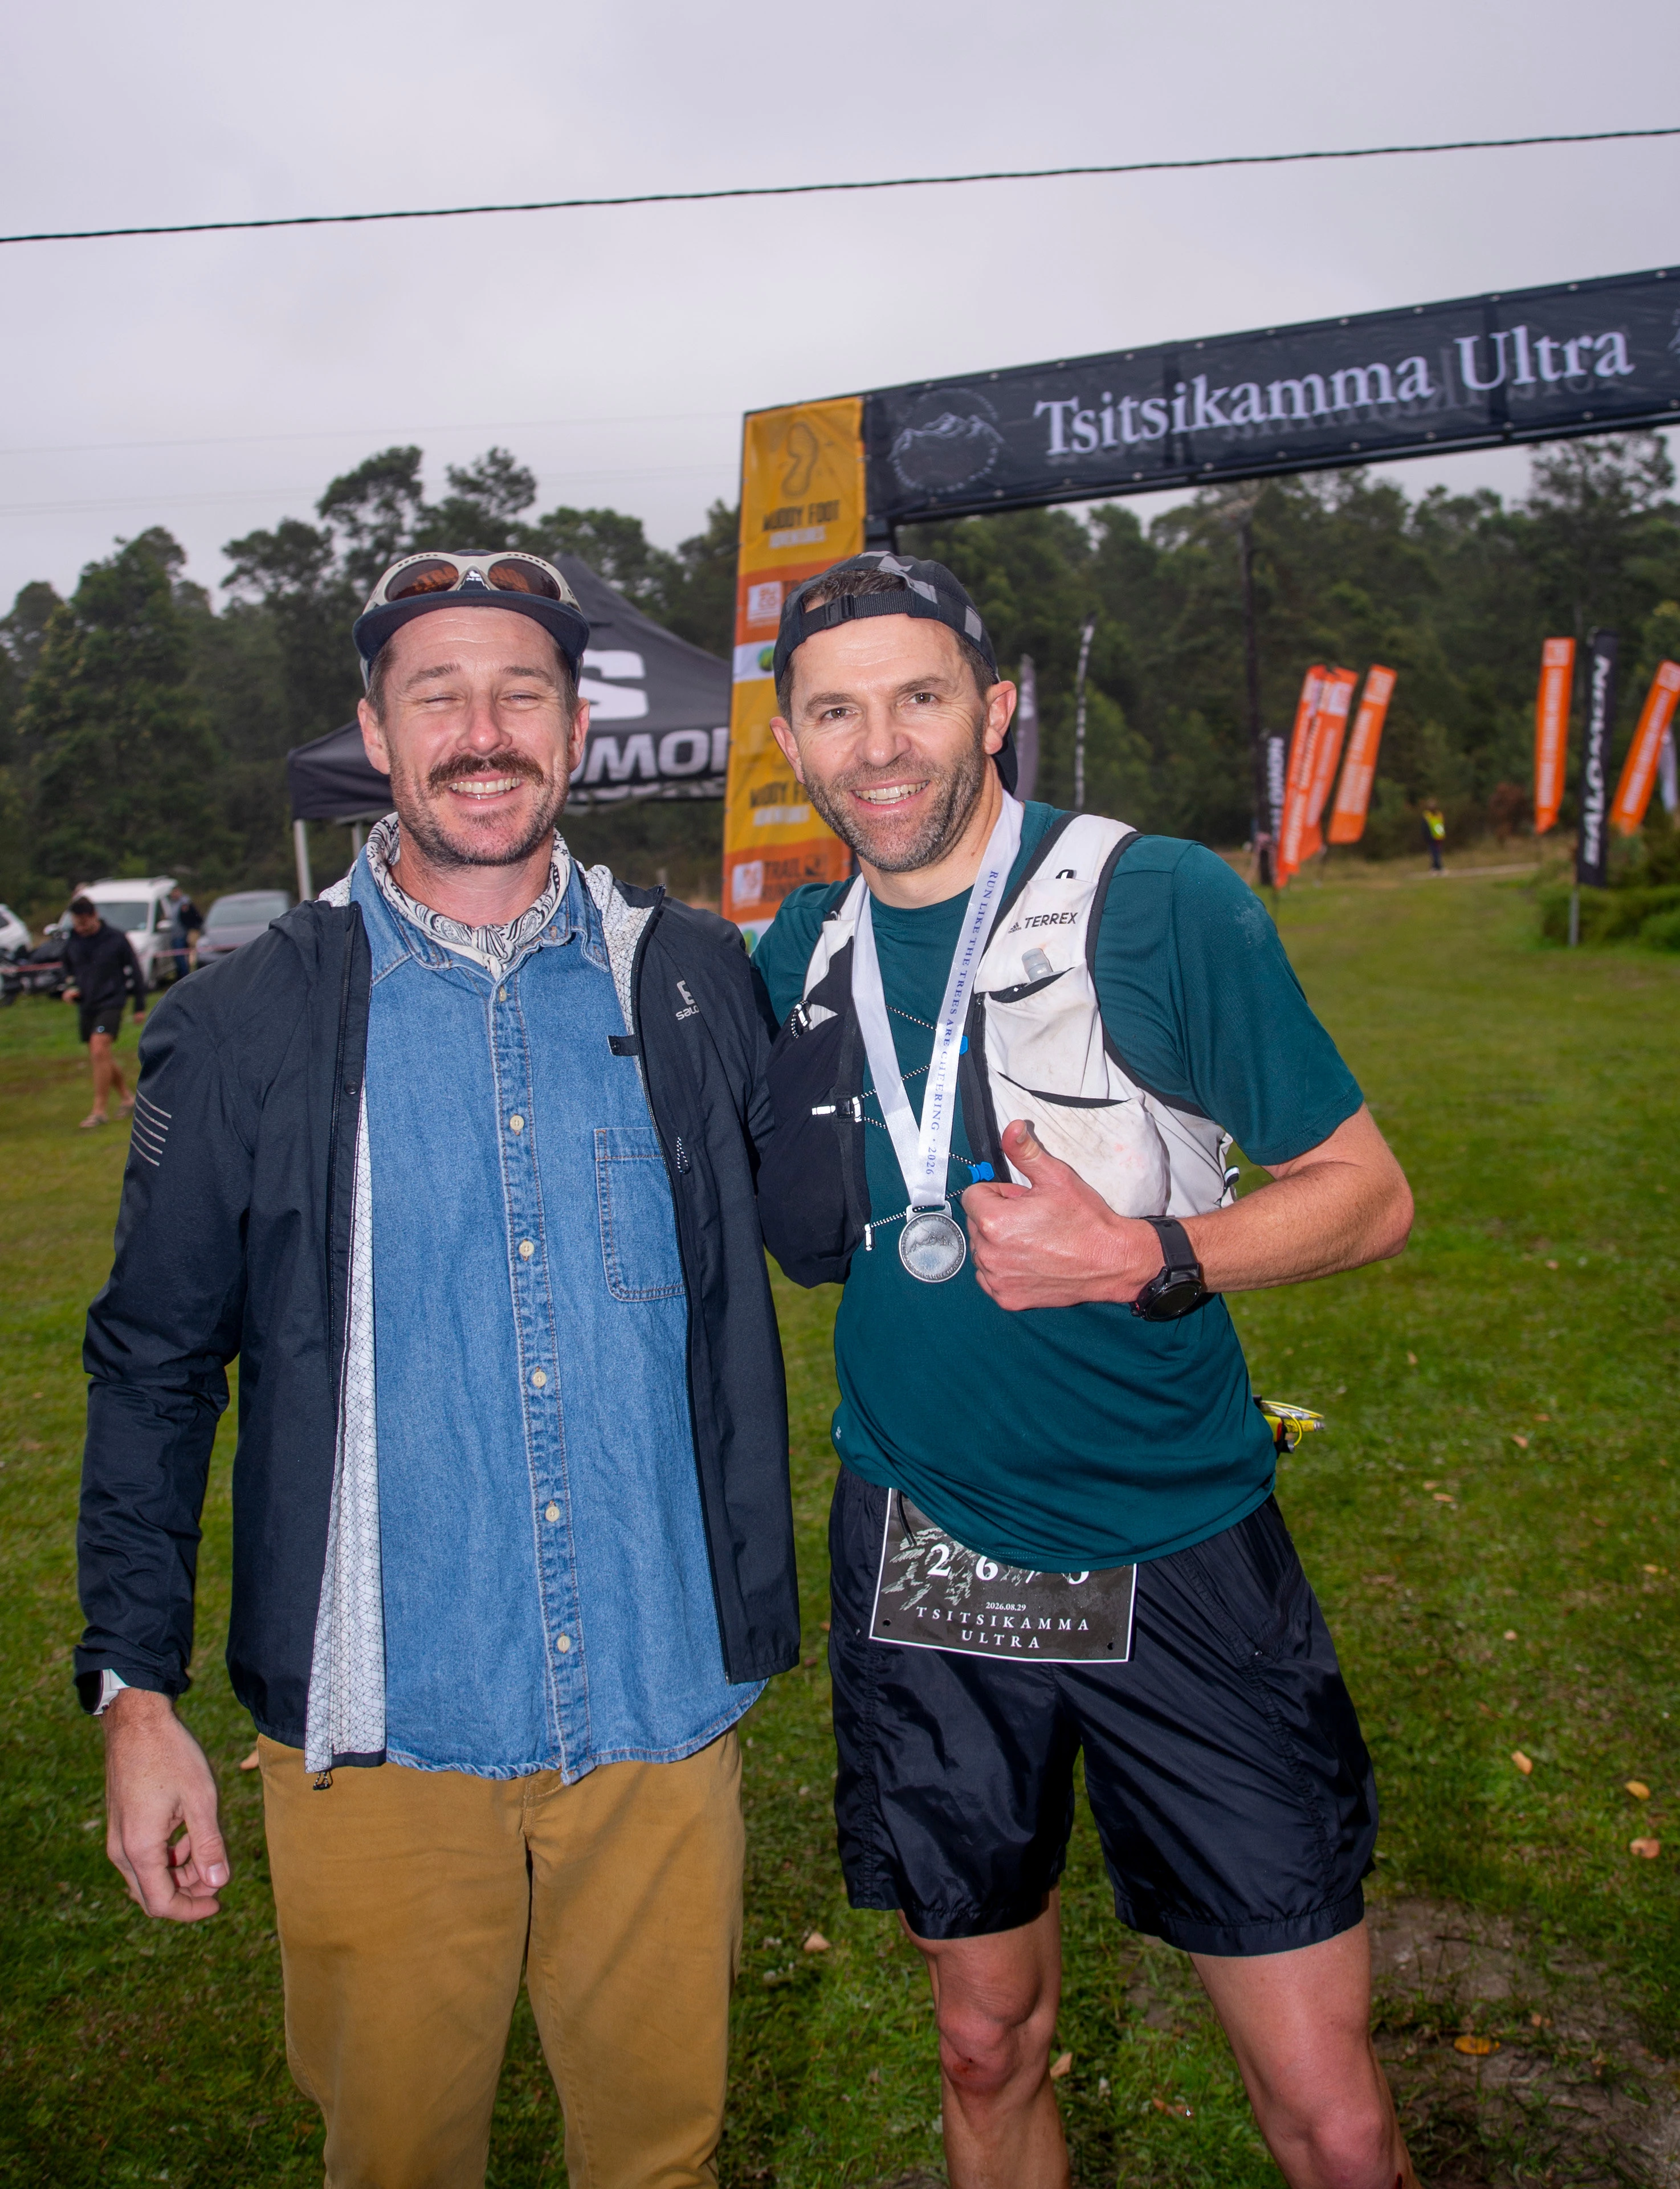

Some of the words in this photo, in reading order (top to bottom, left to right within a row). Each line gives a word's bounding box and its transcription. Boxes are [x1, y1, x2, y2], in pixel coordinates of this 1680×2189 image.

[1033, 354, 1436, 455] Tsitsikamma
[1454, 324, 1636, 392] Ultra
[570, 727, 729, 784] MO
[982, 870, 999, 899] RUN
[972, 903, 988, 934] LIKE
[1025, 912, 1078, 929] TERREX
[962, 937, 977, 967] THE
[949, 970, 967, 1014] TREES
[943, 1019, 955, 1047] ARE
[931, 1051, 948, 1131] CHEERING
[925, 1147, 937, 1175] 2026
[915, 1606, 1089, 1631] TSITSIKAMMA
[985, 1601, 1027, 1612] 2026.08.29
[961, 1629, 1041, 1649] ULTRA
